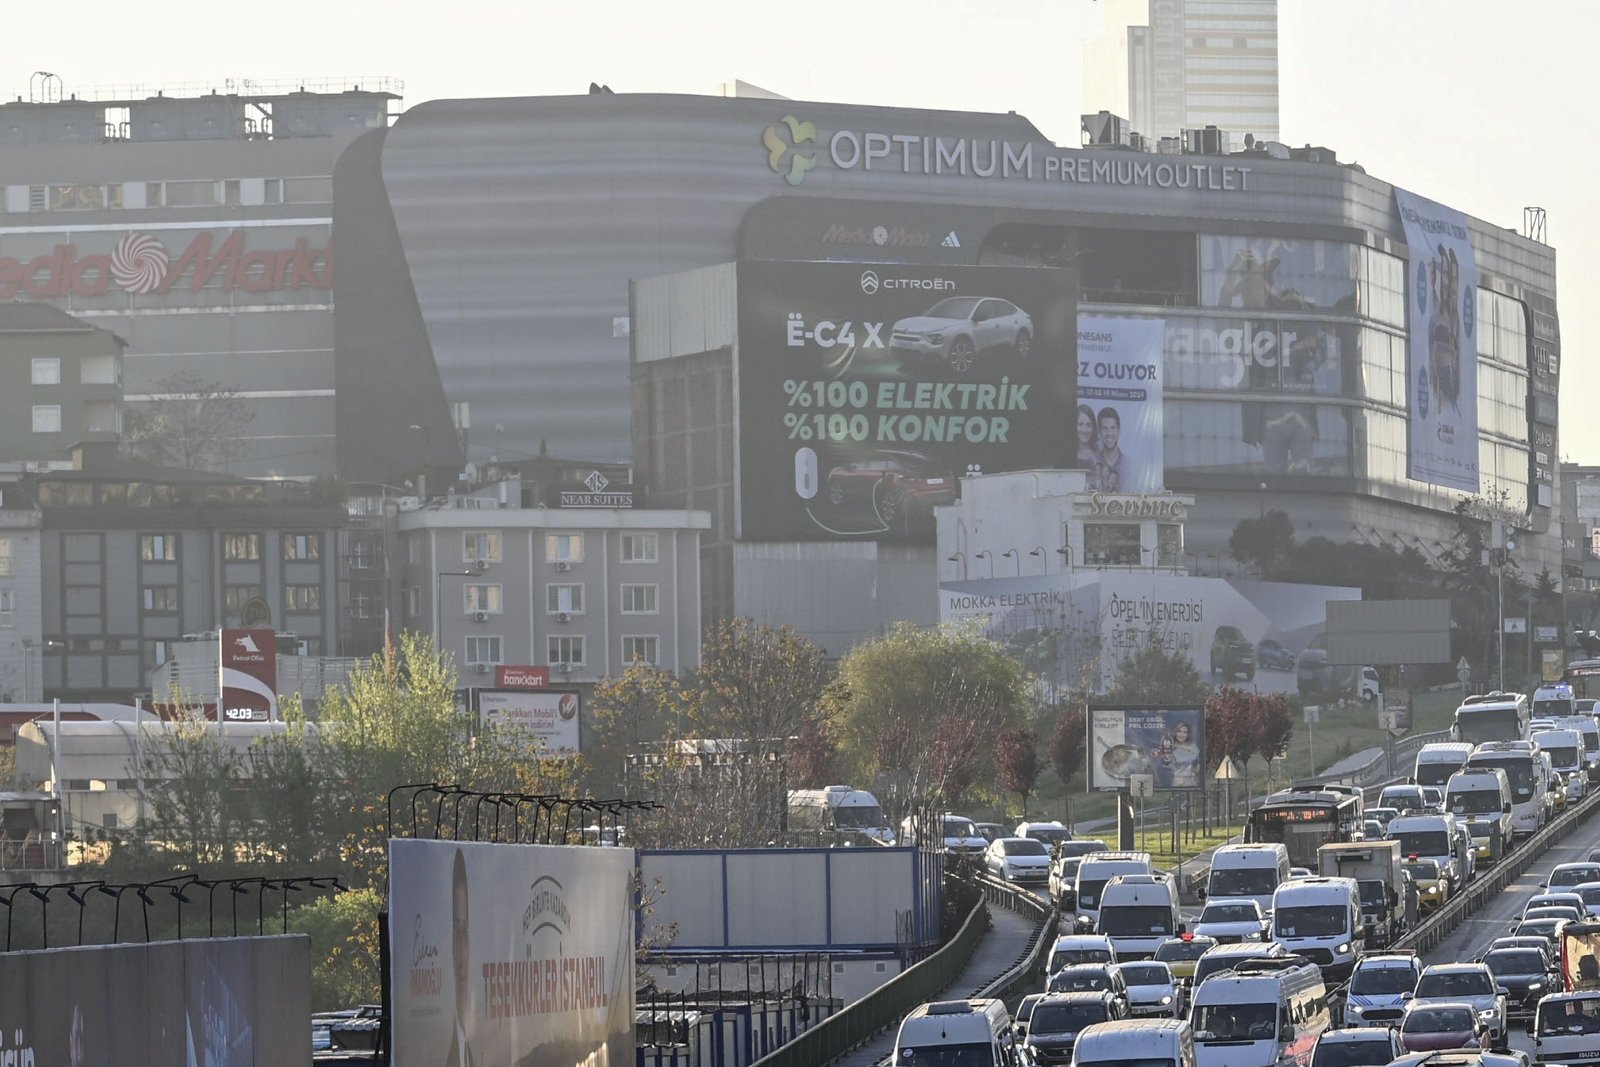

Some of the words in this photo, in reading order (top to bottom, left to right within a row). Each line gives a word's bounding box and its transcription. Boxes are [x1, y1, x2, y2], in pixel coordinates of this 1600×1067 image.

[830, 130, 1033, 180] OPTIMUM
[1045, 156, 1151, 186] PREMIUM
[1155, 163, 1252, 192] OUTLET
[1094, 361, 1157, 381] OLUYOR
[783, 379, 869, 408] %100
[876, 376, 1031, 411] ELEKTRİK
[783, 412, 870, 441] %100
[876, 414, 1010, 444] KONFOR
[561, 494, 591, 505] NEAR
[593, 494, 633, 505] SUITES
[950, 595, 996, 610] MOKKA
[1157, 599, 1203, 623] ENERJİSİ
[226, 708, 252, 719] 42.03
[559, 941, 608, 1011] İSTANBUL
